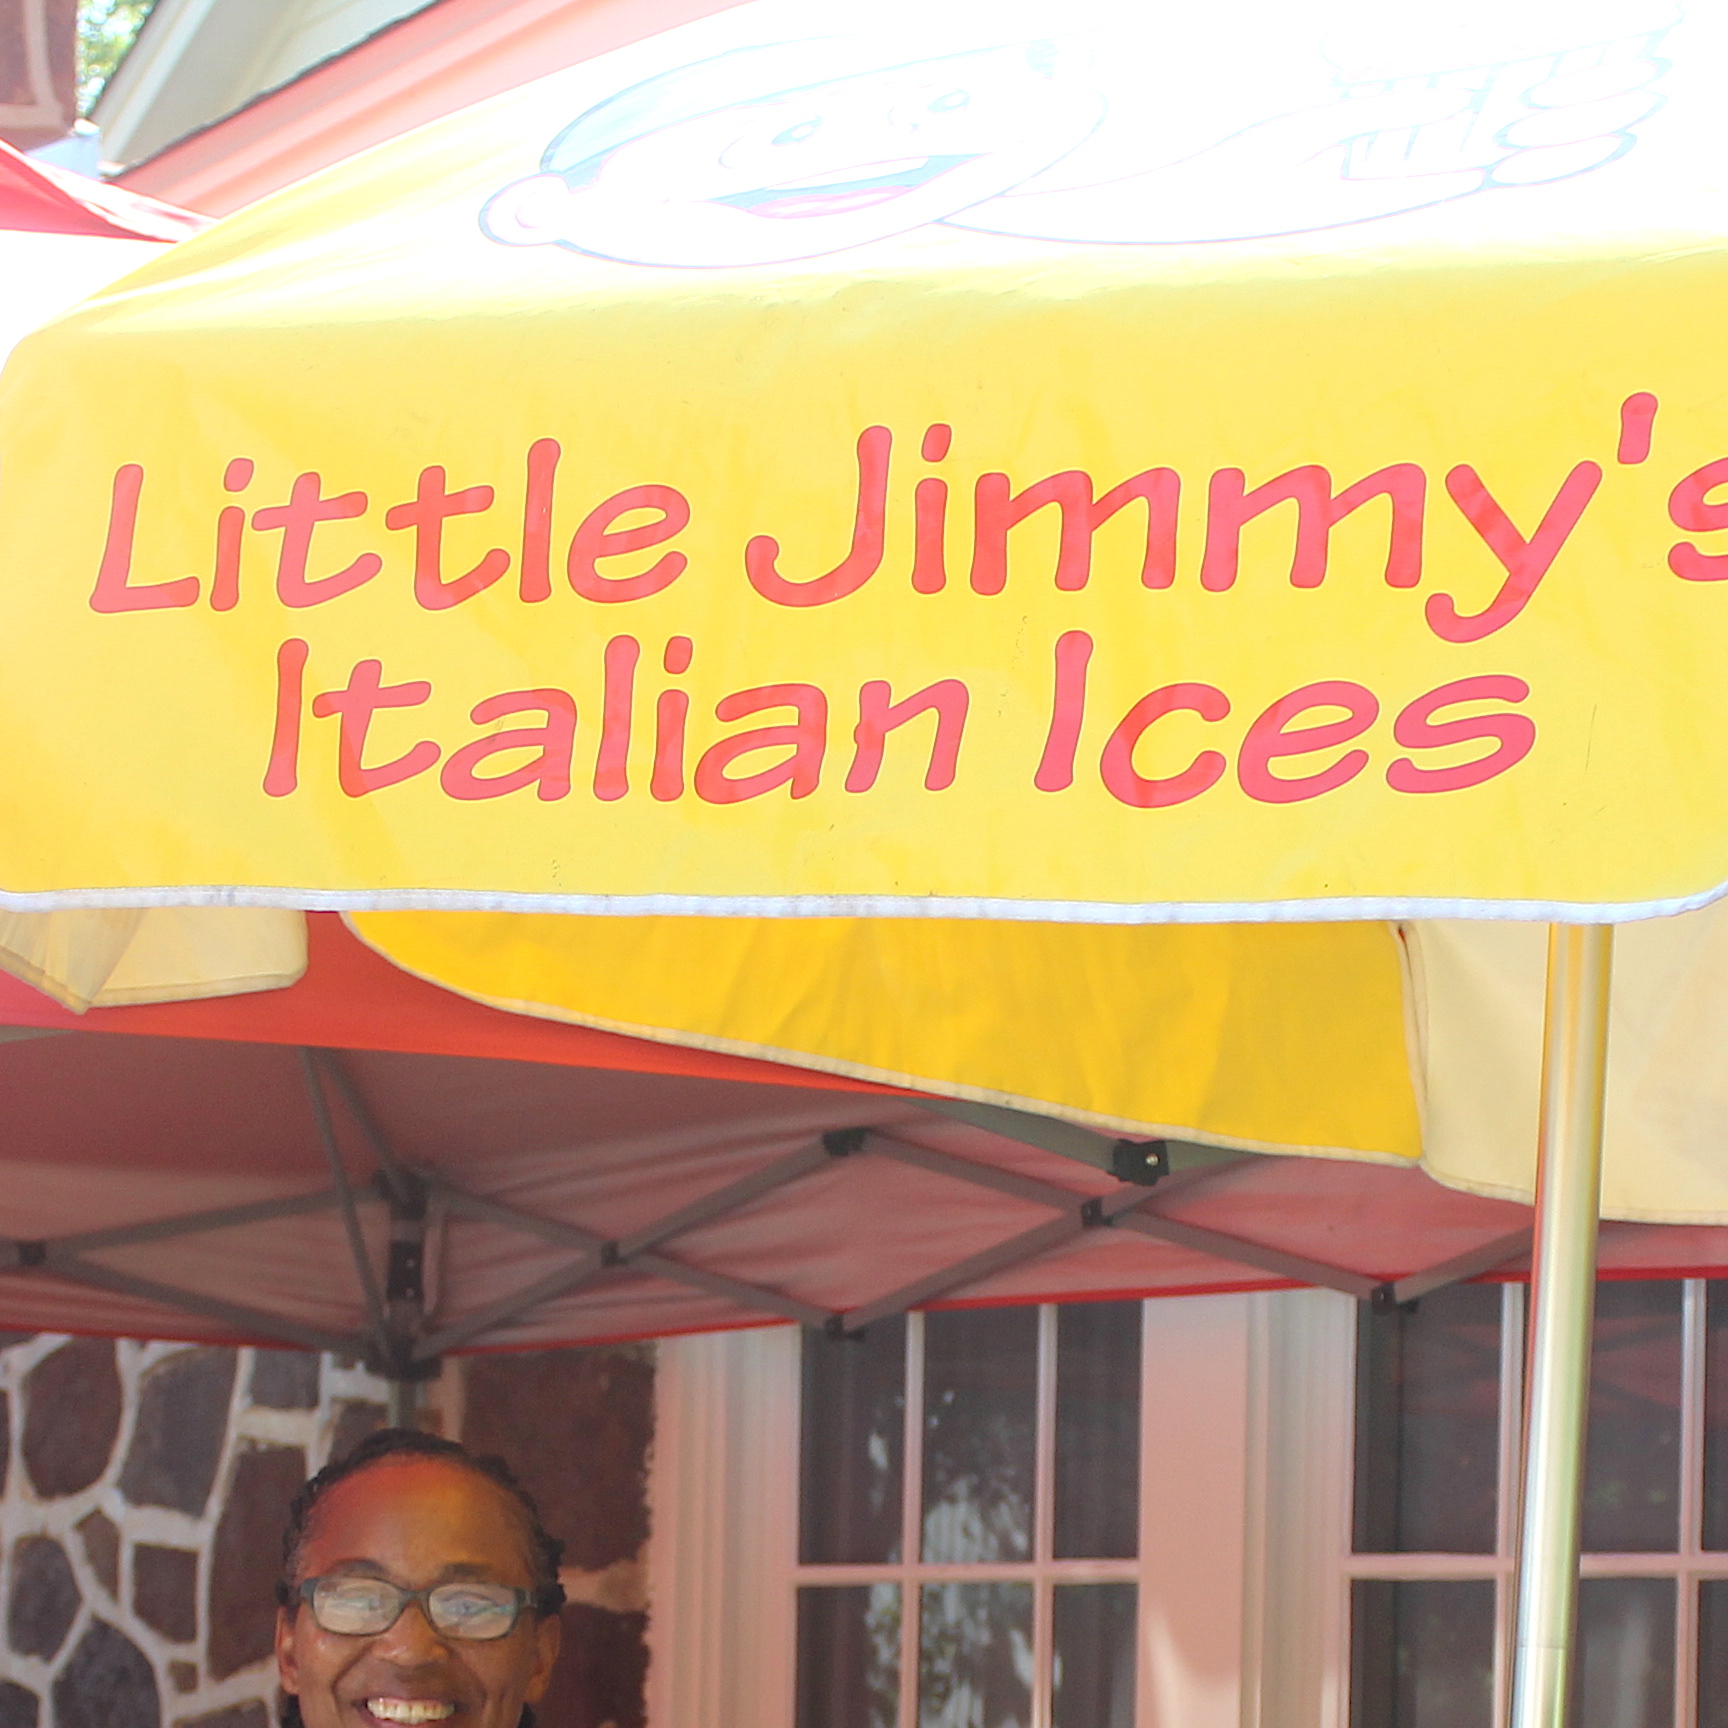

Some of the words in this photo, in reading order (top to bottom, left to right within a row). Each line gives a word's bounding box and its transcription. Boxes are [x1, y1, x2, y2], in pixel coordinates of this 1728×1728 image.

[90, 436, 689, 615] Little
[262, 634, 962, 806] Italian
[1032, 630, 1537, 808] Ices
